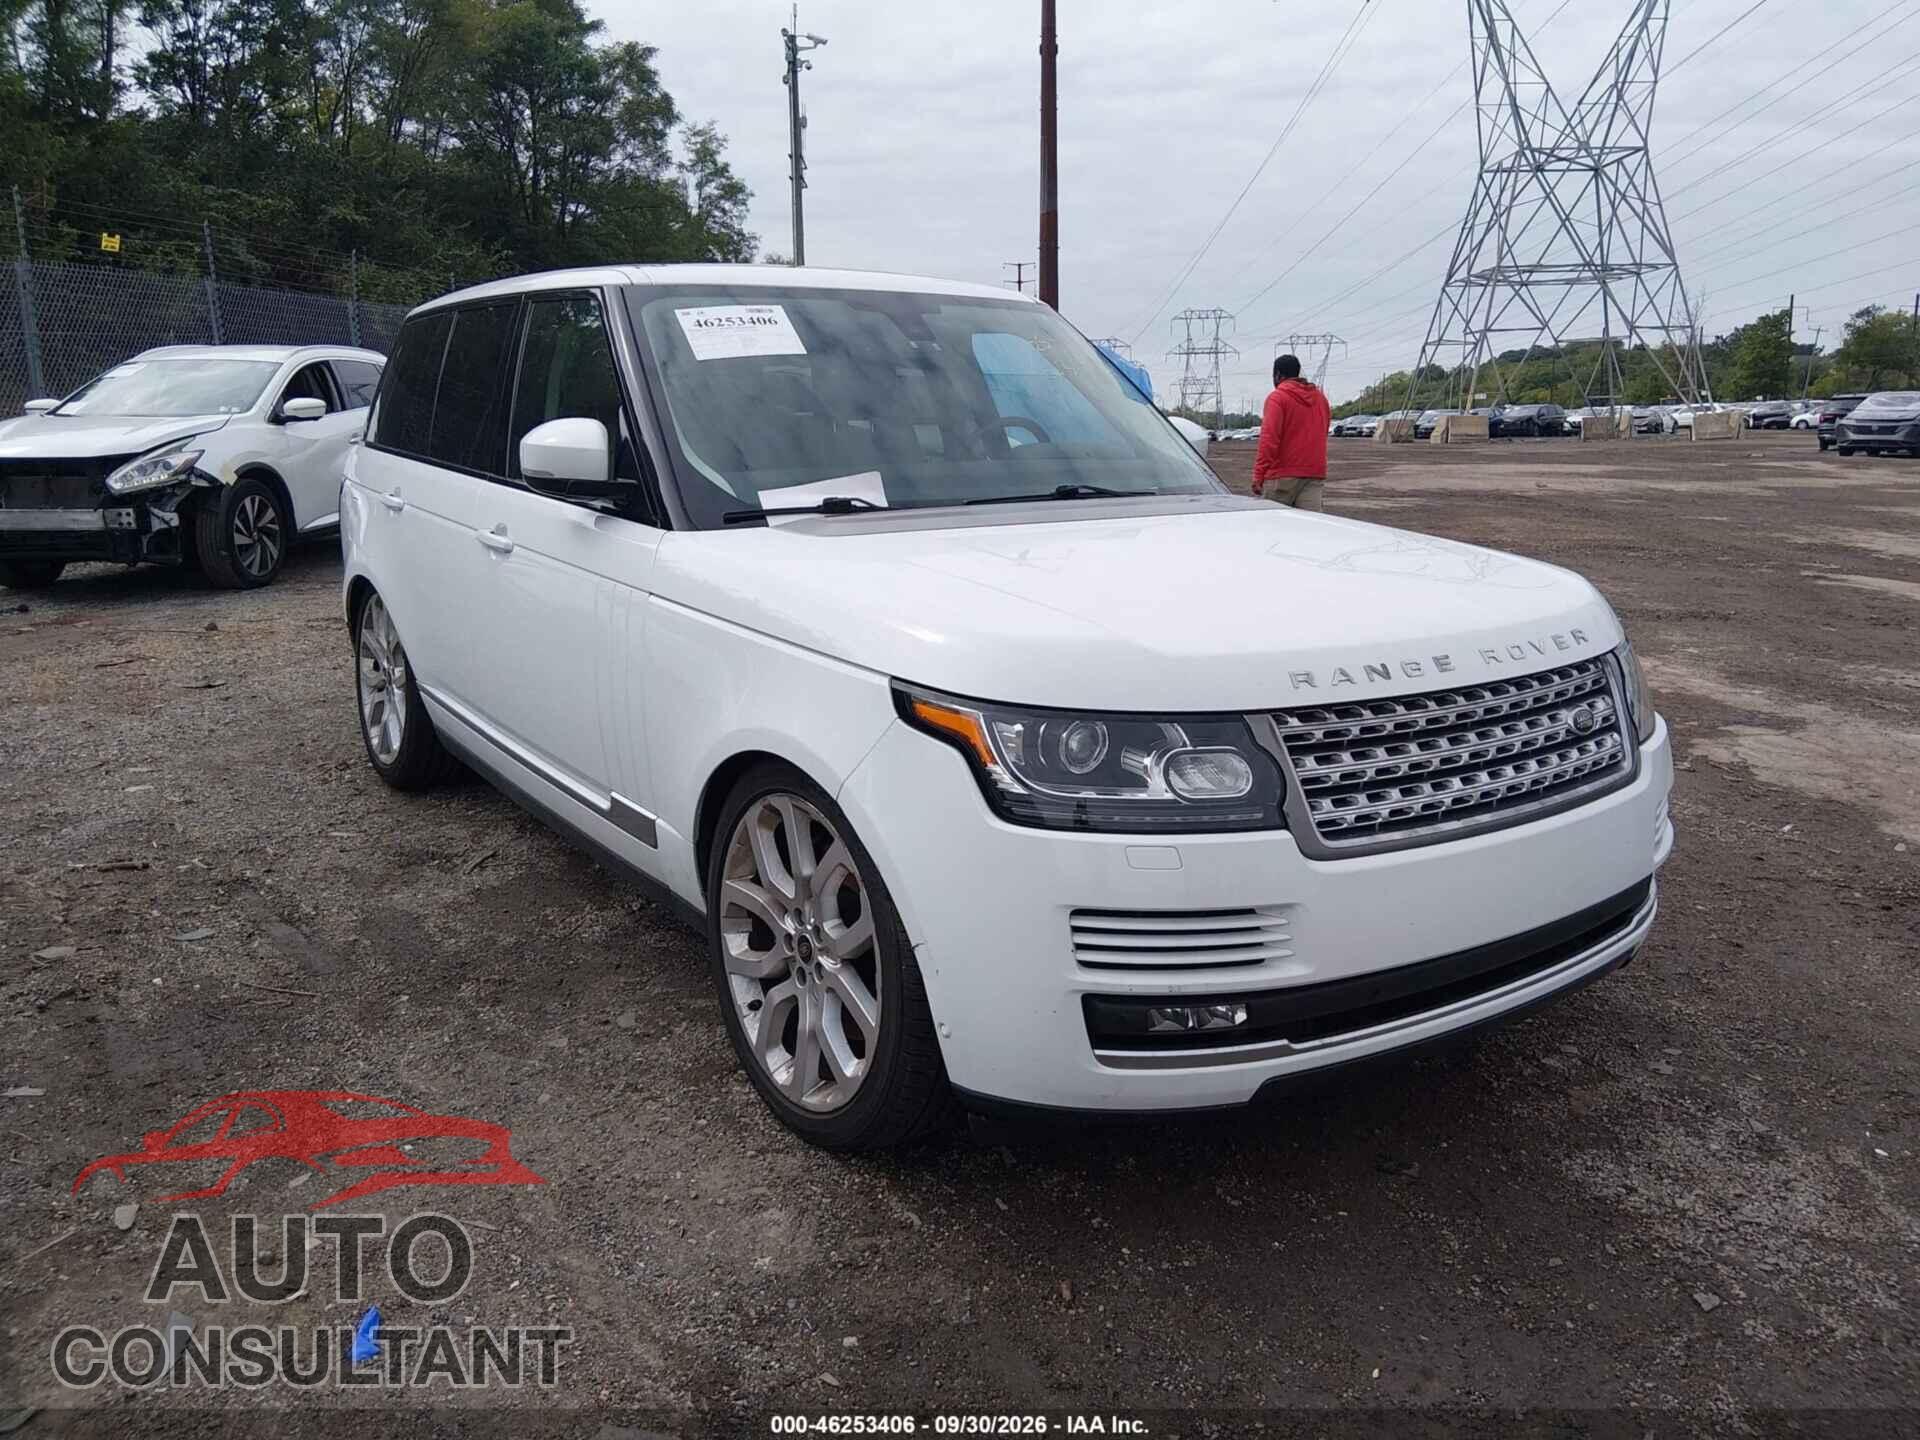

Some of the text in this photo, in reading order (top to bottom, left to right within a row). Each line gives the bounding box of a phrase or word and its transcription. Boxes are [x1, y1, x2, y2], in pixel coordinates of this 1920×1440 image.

[694, 316, 778, 328] 46253406
[1288, 628, 1590, 690] RANGE ROVER
